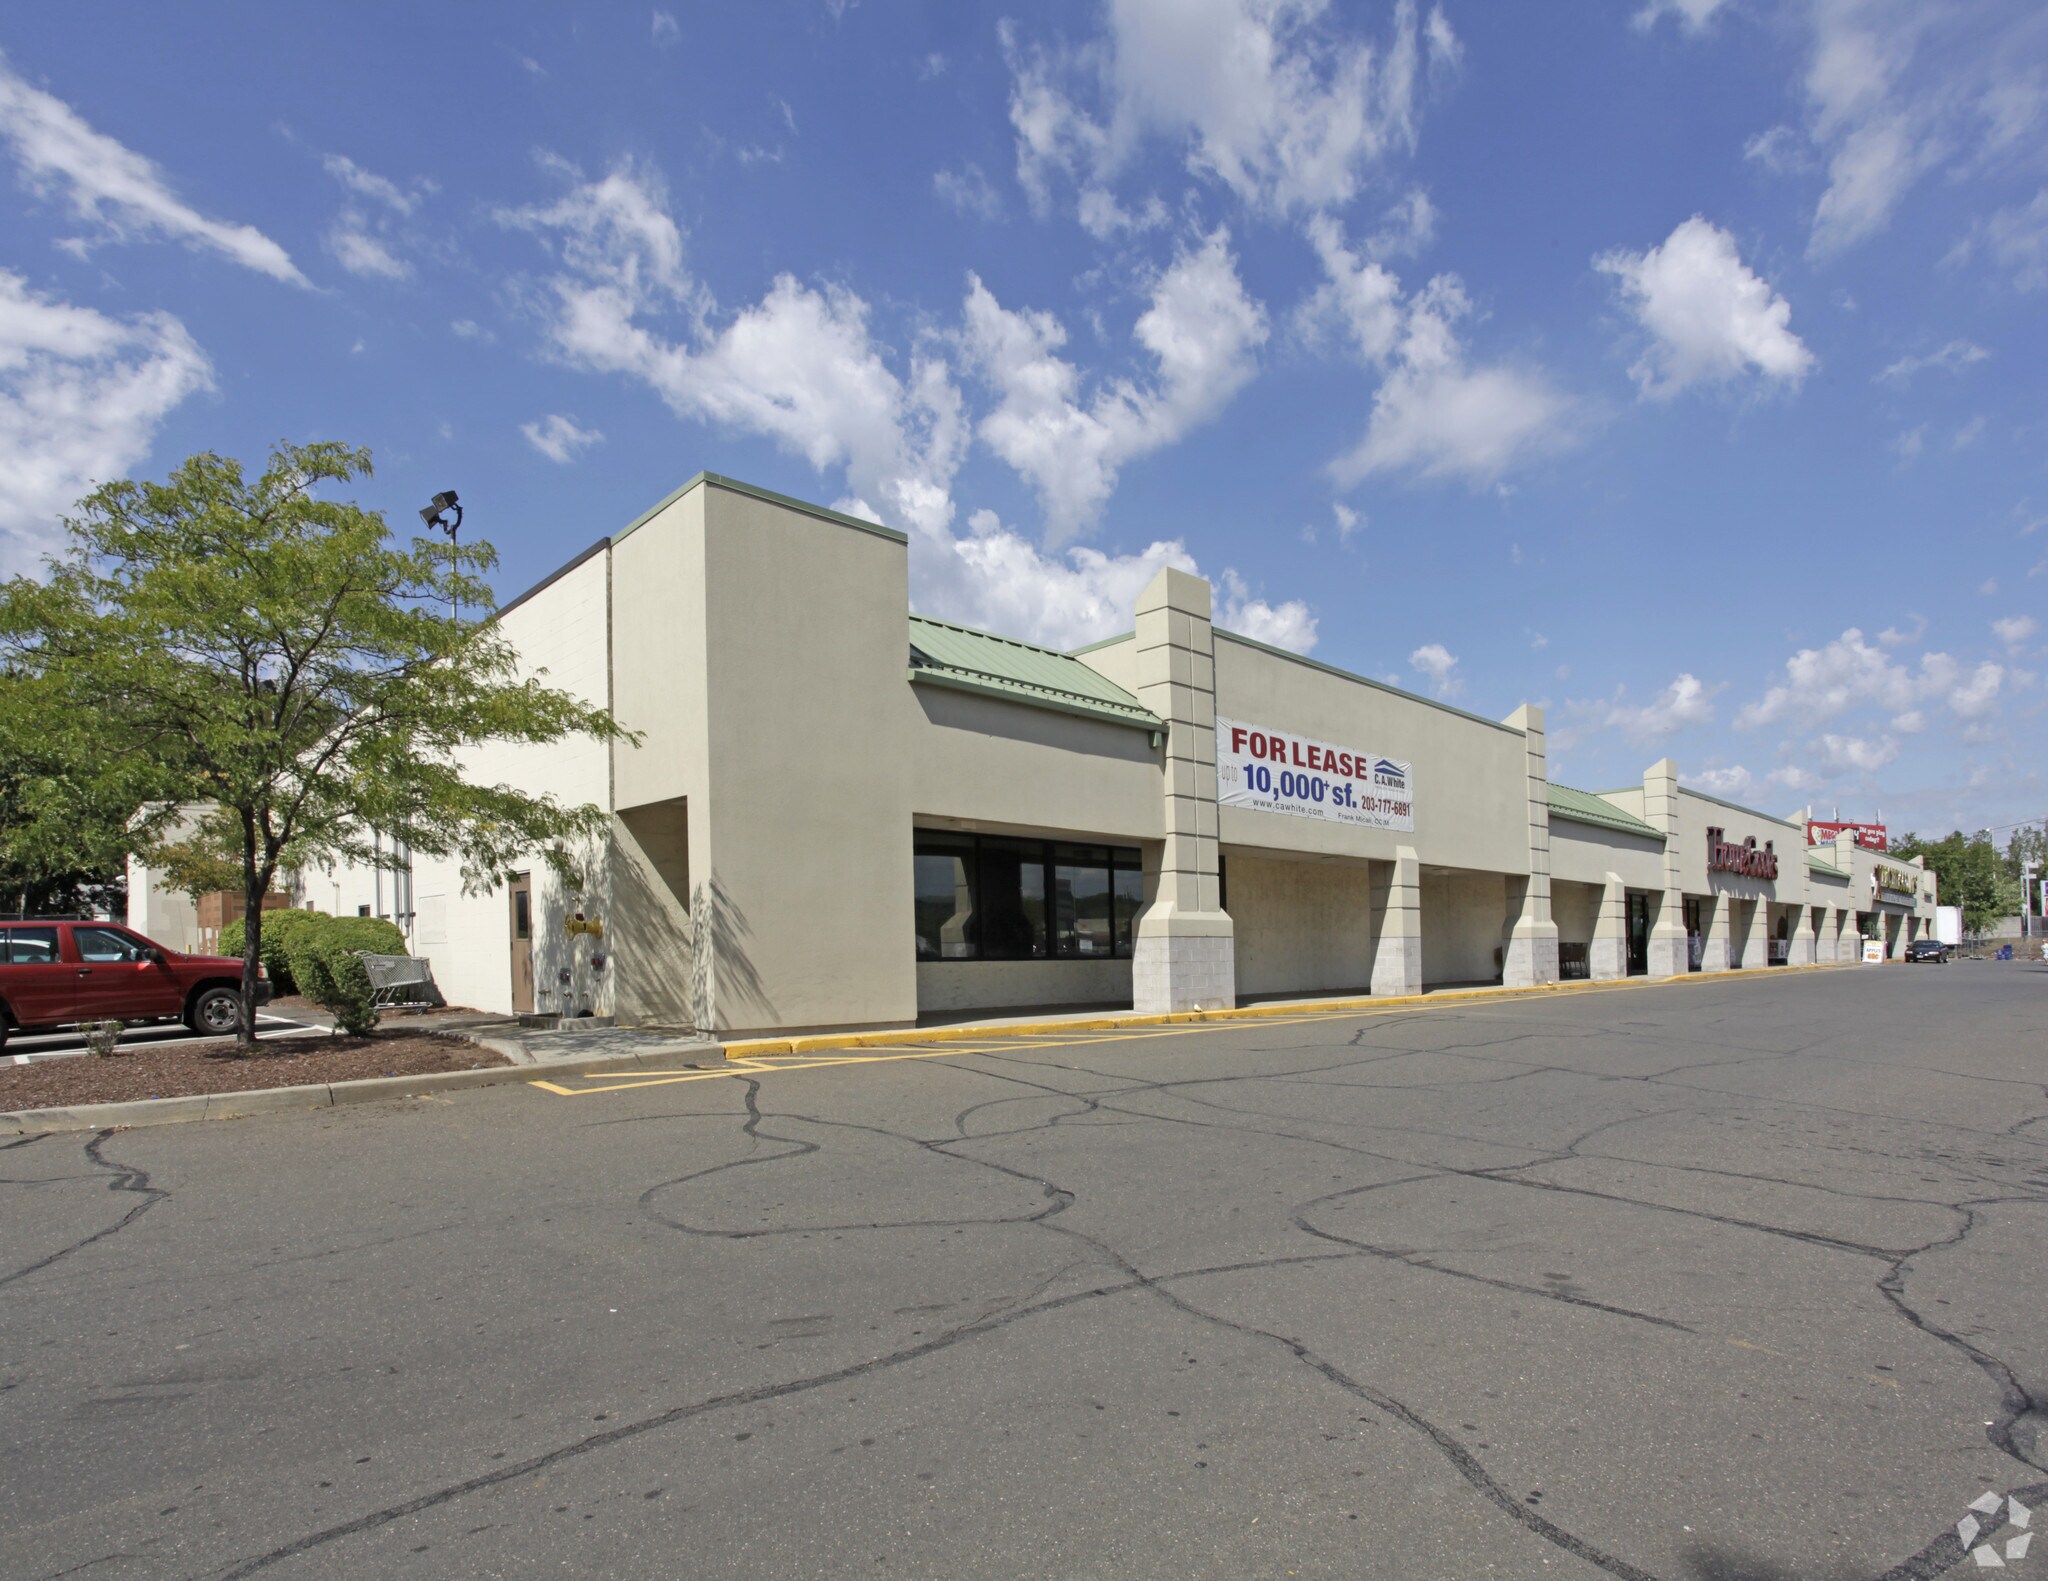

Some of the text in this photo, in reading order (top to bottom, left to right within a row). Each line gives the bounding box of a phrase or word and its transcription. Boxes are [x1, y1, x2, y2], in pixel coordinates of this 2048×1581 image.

[1232, 727, 1367, 780] FOR LEASE
[1221, 764, 1238, 787] up to
[1332, 783, 1357, 809] sf.
[1361, 795, 1411, 817] 203-777-6891
[1252, 799, 1324, 816] www.cawhite.com
[1337, 812, 1354, 820] Frank
